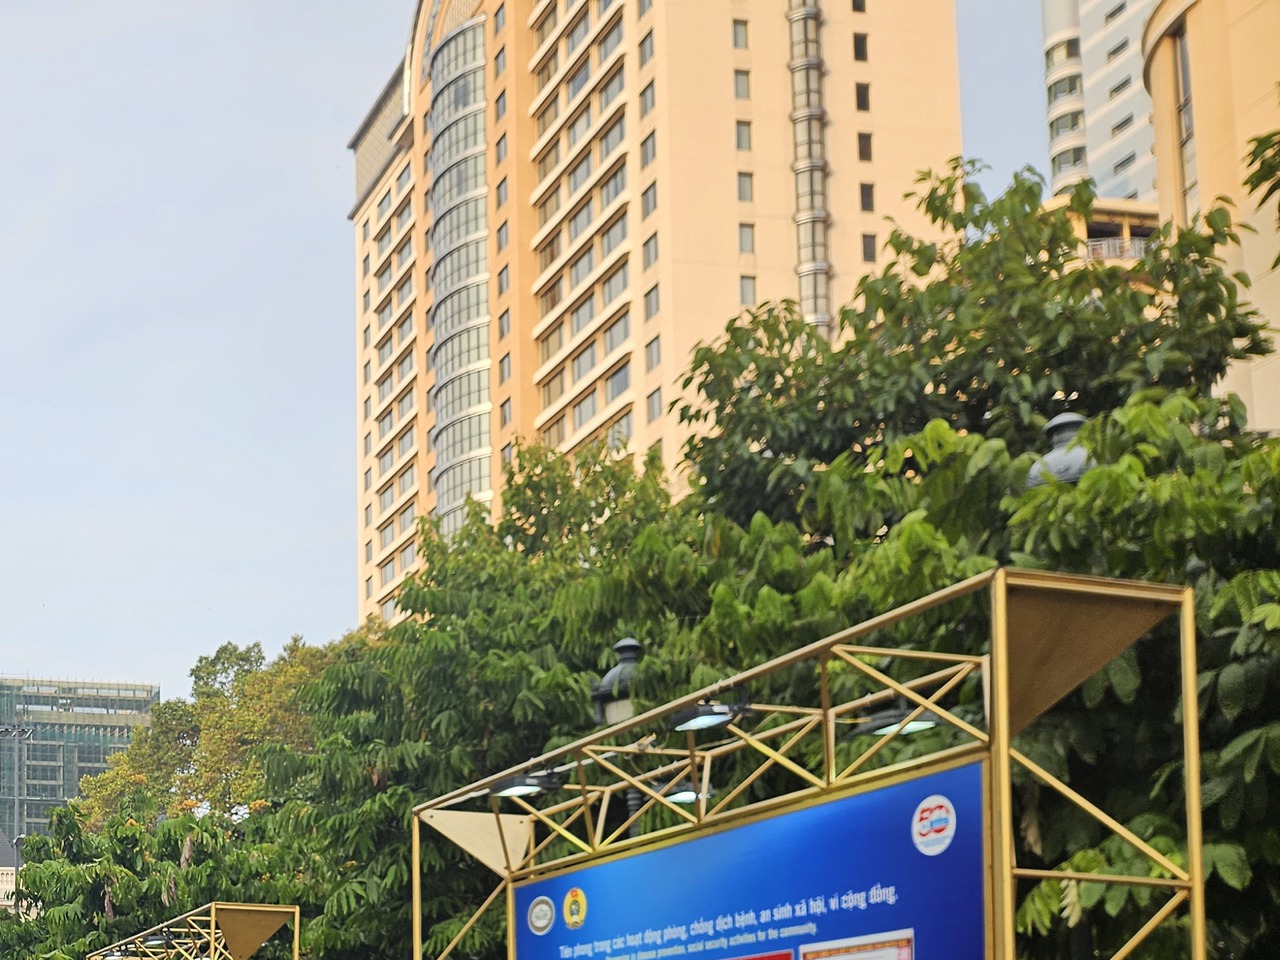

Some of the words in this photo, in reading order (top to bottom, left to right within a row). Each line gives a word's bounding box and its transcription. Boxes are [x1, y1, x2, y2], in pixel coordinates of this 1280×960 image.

[759, 908, 771, 924] an
[772, 901, 793, 921] sinh
[794, 898, 807, 917] xã
[840, 889, 868, 911] cộng
